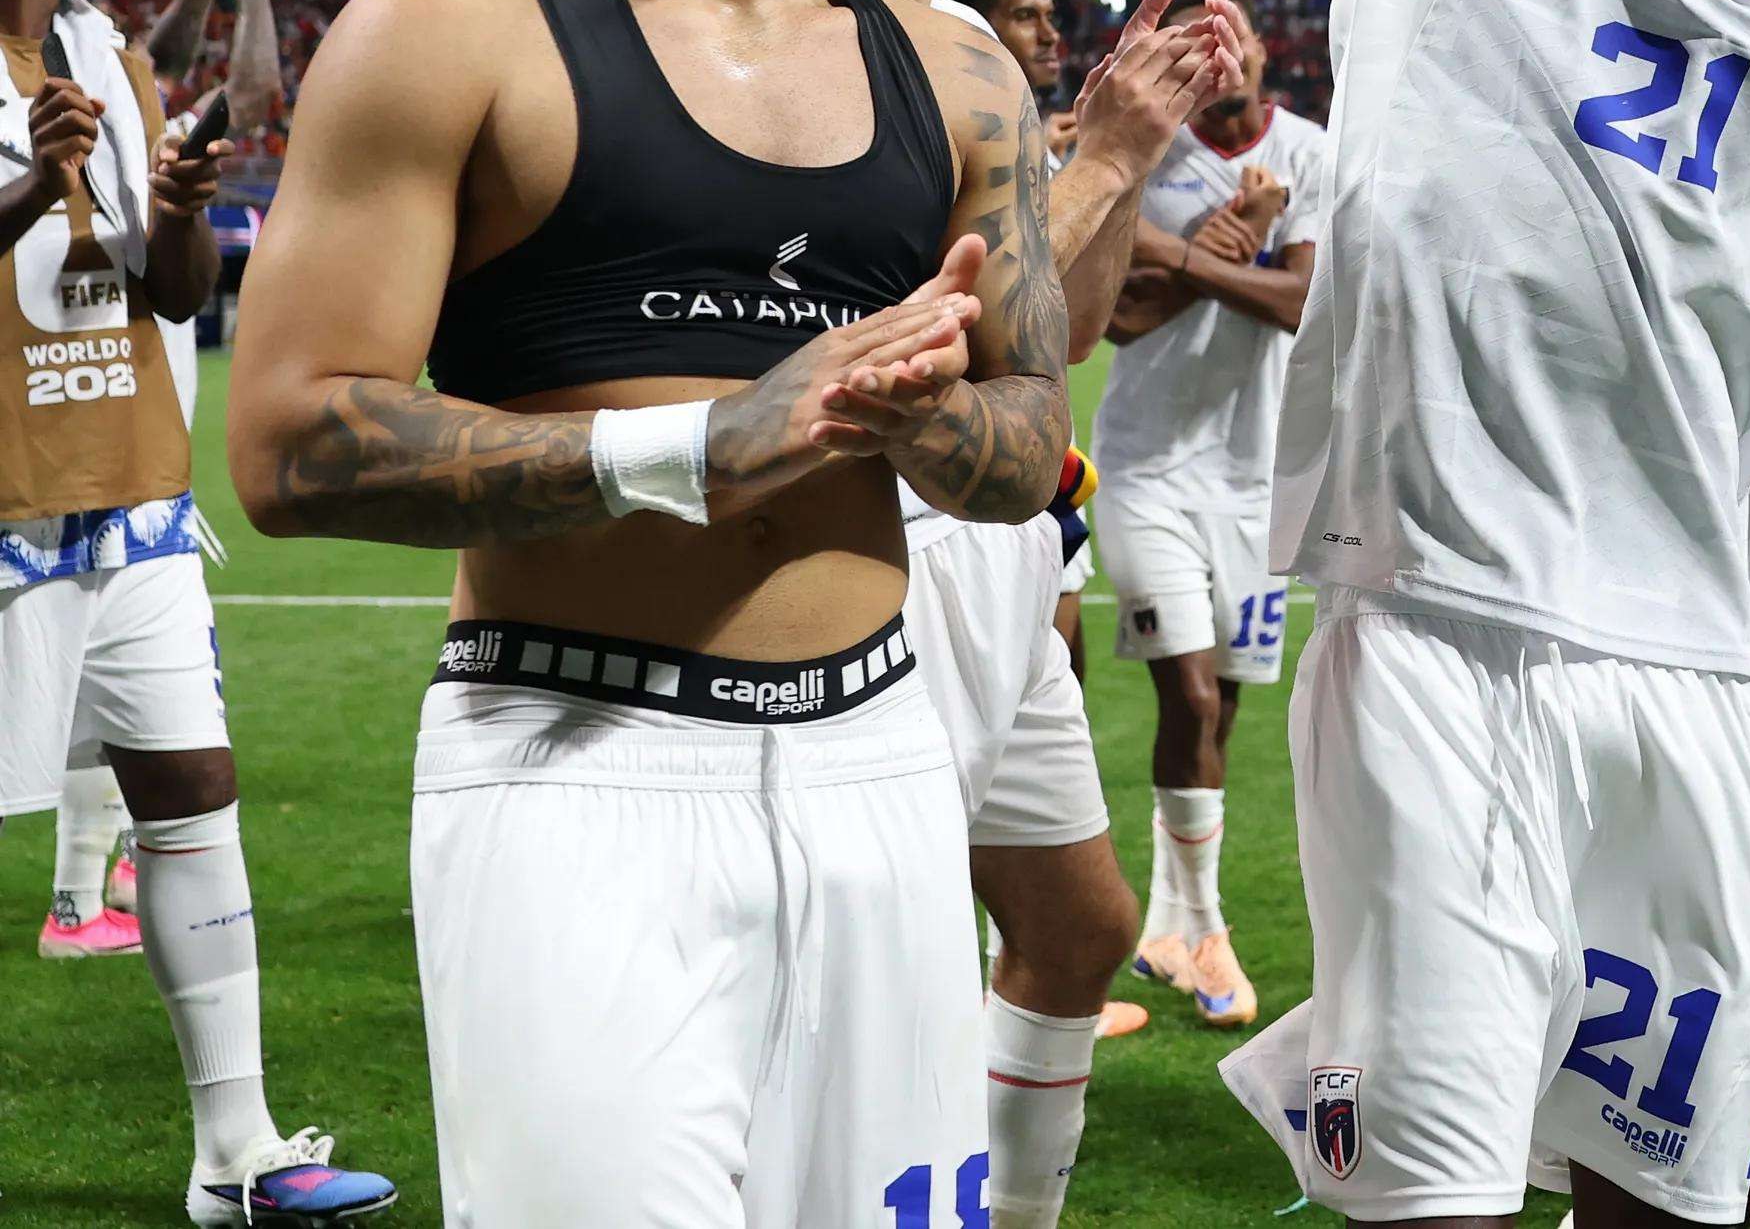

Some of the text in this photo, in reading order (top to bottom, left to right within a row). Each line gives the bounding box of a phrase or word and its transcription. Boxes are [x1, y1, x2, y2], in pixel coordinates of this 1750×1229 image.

[61, 282, 122, 308] FIFA
[22, 337, 119, 367] WORLD
[1229, 590, 1285, 648] 15
[438, 630, 503, 670] apelli
[450, 660, 497, 673] SPORT
[709, 667, 825, 713] capelli
[766, 698, 825, 716] SPORT
[1560, 947, 1722, 1129] 21
[1314, 1073, 1355, 1092] FCF
[1600, 1103, 1688, 1161] capelli
[1630, 1140, 1680, 1168] SPORT
